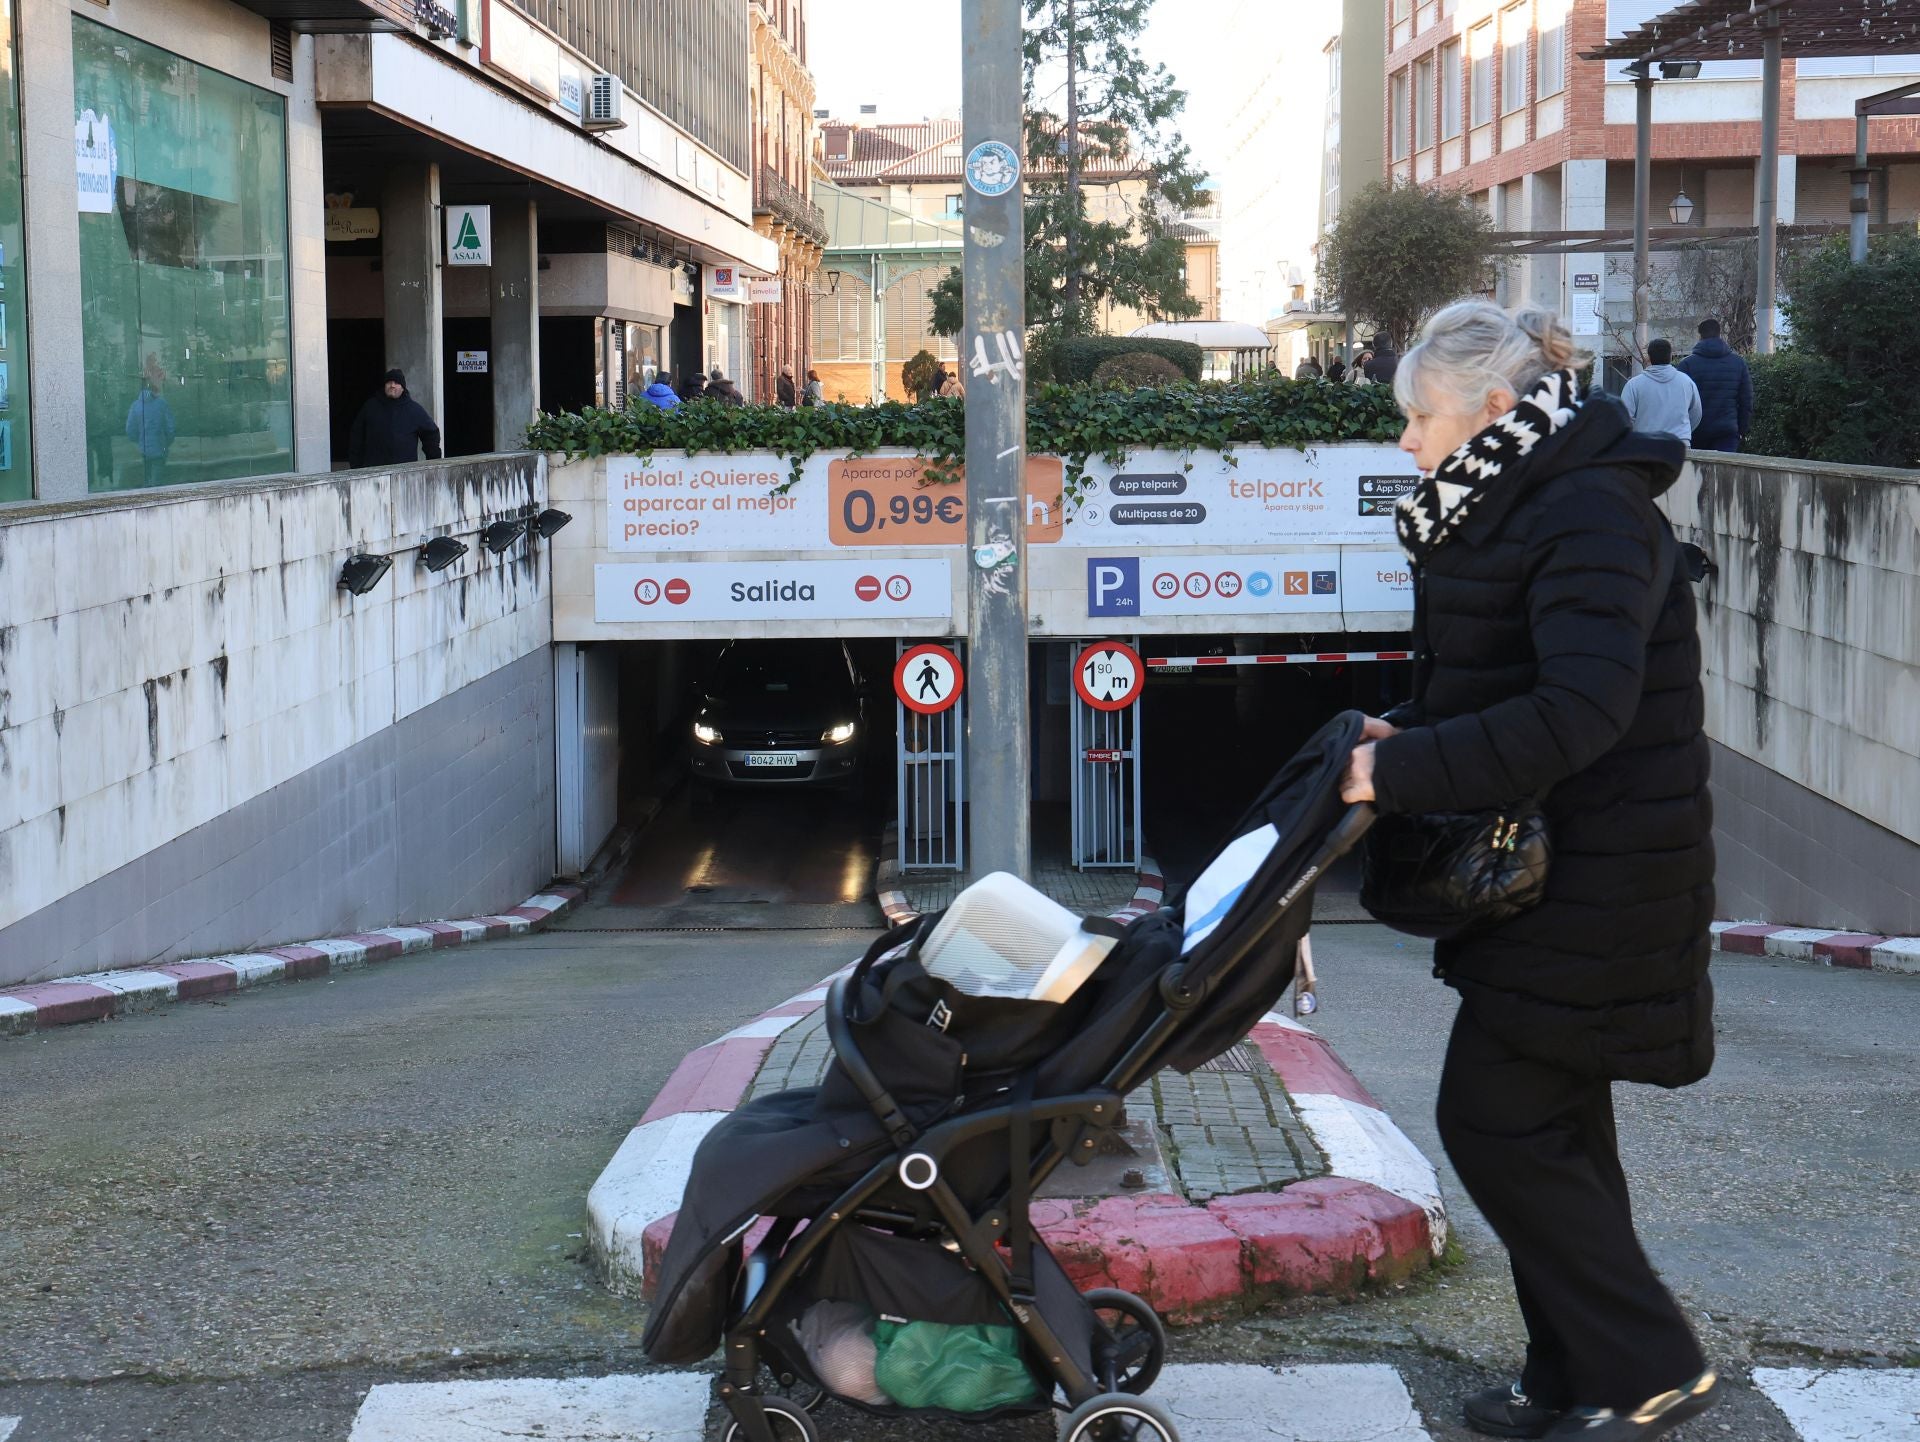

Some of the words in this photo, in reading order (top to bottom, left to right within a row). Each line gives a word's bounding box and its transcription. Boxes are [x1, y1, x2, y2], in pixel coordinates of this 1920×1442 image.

[453, 252, 482, 260] ASAJA
[624, 470, 683, 489] ¡Hola!
[689, 469, 780, 489] ¿Quieres
[841, 468, 891, 481] Aparca
[895, 468, 918, 482] por
[1118, 480, 1139, 491] App
[1142, 479, 1178, 491] telpark
[1229, 478, 1324, 503] telpark
[1376, 485, 1394, 493] App
[1394, 484, 1417, 492] Store
[623, 497, 707, 516] aparcar
[712, 494, 731, 510] al
[737, 495, 797, 515] mejor
[843, 489, 964, 534] 0,99€
[1264, 504, 1294, 512] Aparca
[1302, 504, 1324, 512] sigue
[1376, 505, 1393, 513] Goo
[1117, 509, 1168, 520] Multipass
[1169, 509, 1183, 518] de
[1185, 508, 1198, 518] 20
[624, 519, 700, 541] precio?
[730, 579, 815, 602] Salida
[1095, 566, 1125, 607] P
[1160, 581, 1173, 590] 20
[1115, 597, 1134, 606] 24h
[1097, 663, 1113, 674] 90
[1112, 676, 1128, 689] m
[751, 756, 774, 765] 8042
[776, 756, 794, 765] HVX
